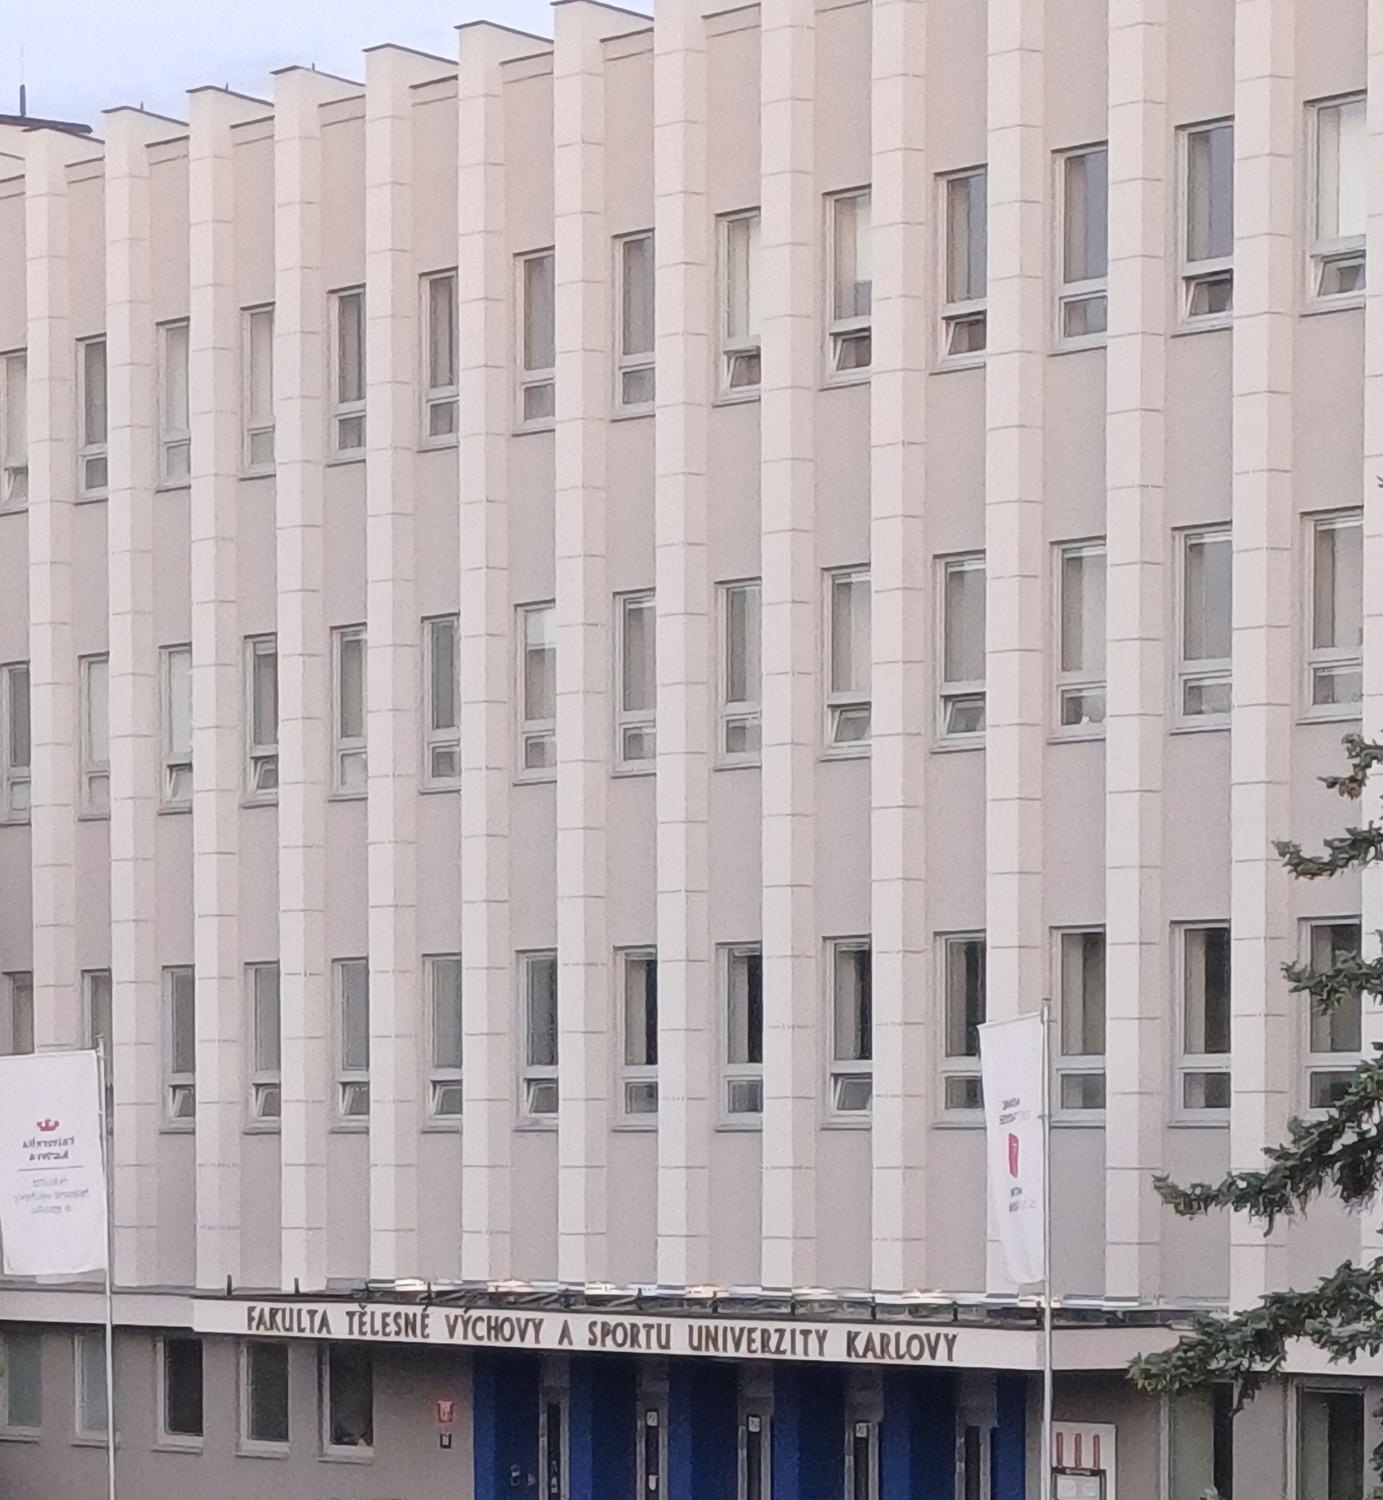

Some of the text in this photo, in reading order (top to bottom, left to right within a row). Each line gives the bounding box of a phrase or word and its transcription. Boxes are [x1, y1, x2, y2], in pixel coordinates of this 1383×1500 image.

[247, 1303, 959, 1361] FAKULTA TĚLESNÉ VÝCHOVY A SPORTU UNIVERZITY KARLOVY
